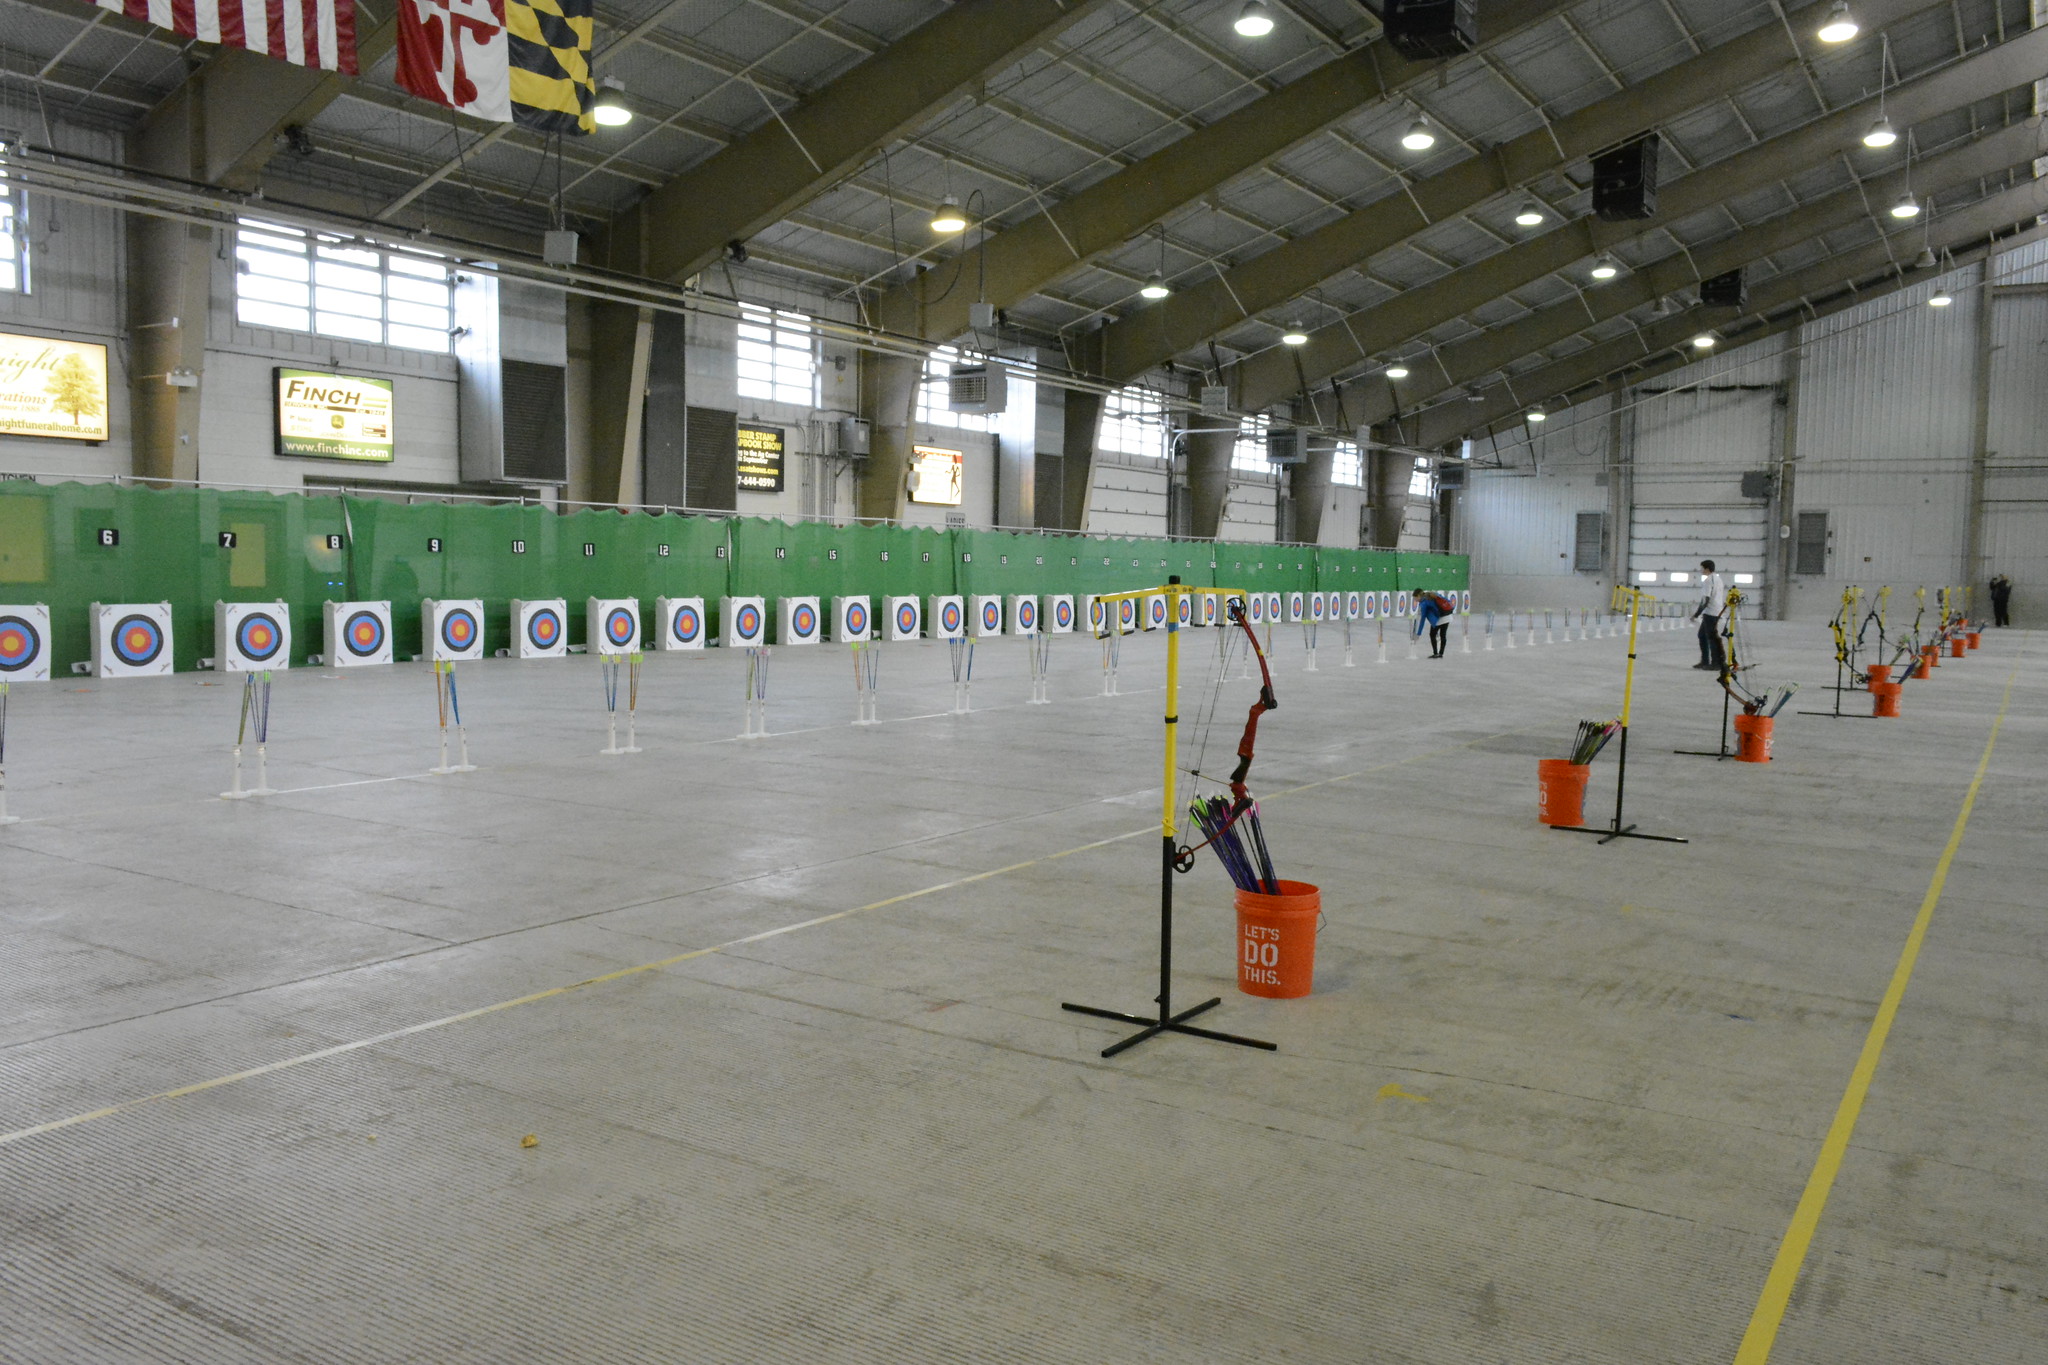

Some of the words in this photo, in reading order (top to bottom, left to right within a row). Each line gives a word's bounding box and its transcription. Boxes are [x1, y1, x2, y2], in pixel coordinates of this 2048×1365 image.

[286, 380, 361, 405] FINCH
[756, 432, 776, 442] STAMP
[286, 442, 388, 458] www.finchinc.com
[763, 441, 782, 451] SHOW
[102, 530, 112, 544] 6
[223, 534, 232, 547] 7
[331, 536, 339, 548] 8
[432, 540, 439, 551] 9
[513, 541, 524, 552] 10
[585, 544, 593, 555] 11
[659, 545, 668, 556] 12
[717, 547, 725, 557] 13
[776, 548, 785, 558] 14
[829, 550, 836, 560] 15
[881, 552, 888, 561] 16
[922, 553, 929, 562] 17
[964, 554, 971, 562] 18
[1245, 924, 1280, 941] LET'S
[1245, 938, 1278, 967] DO
[1244, 964, 1281, 985] THIS.
